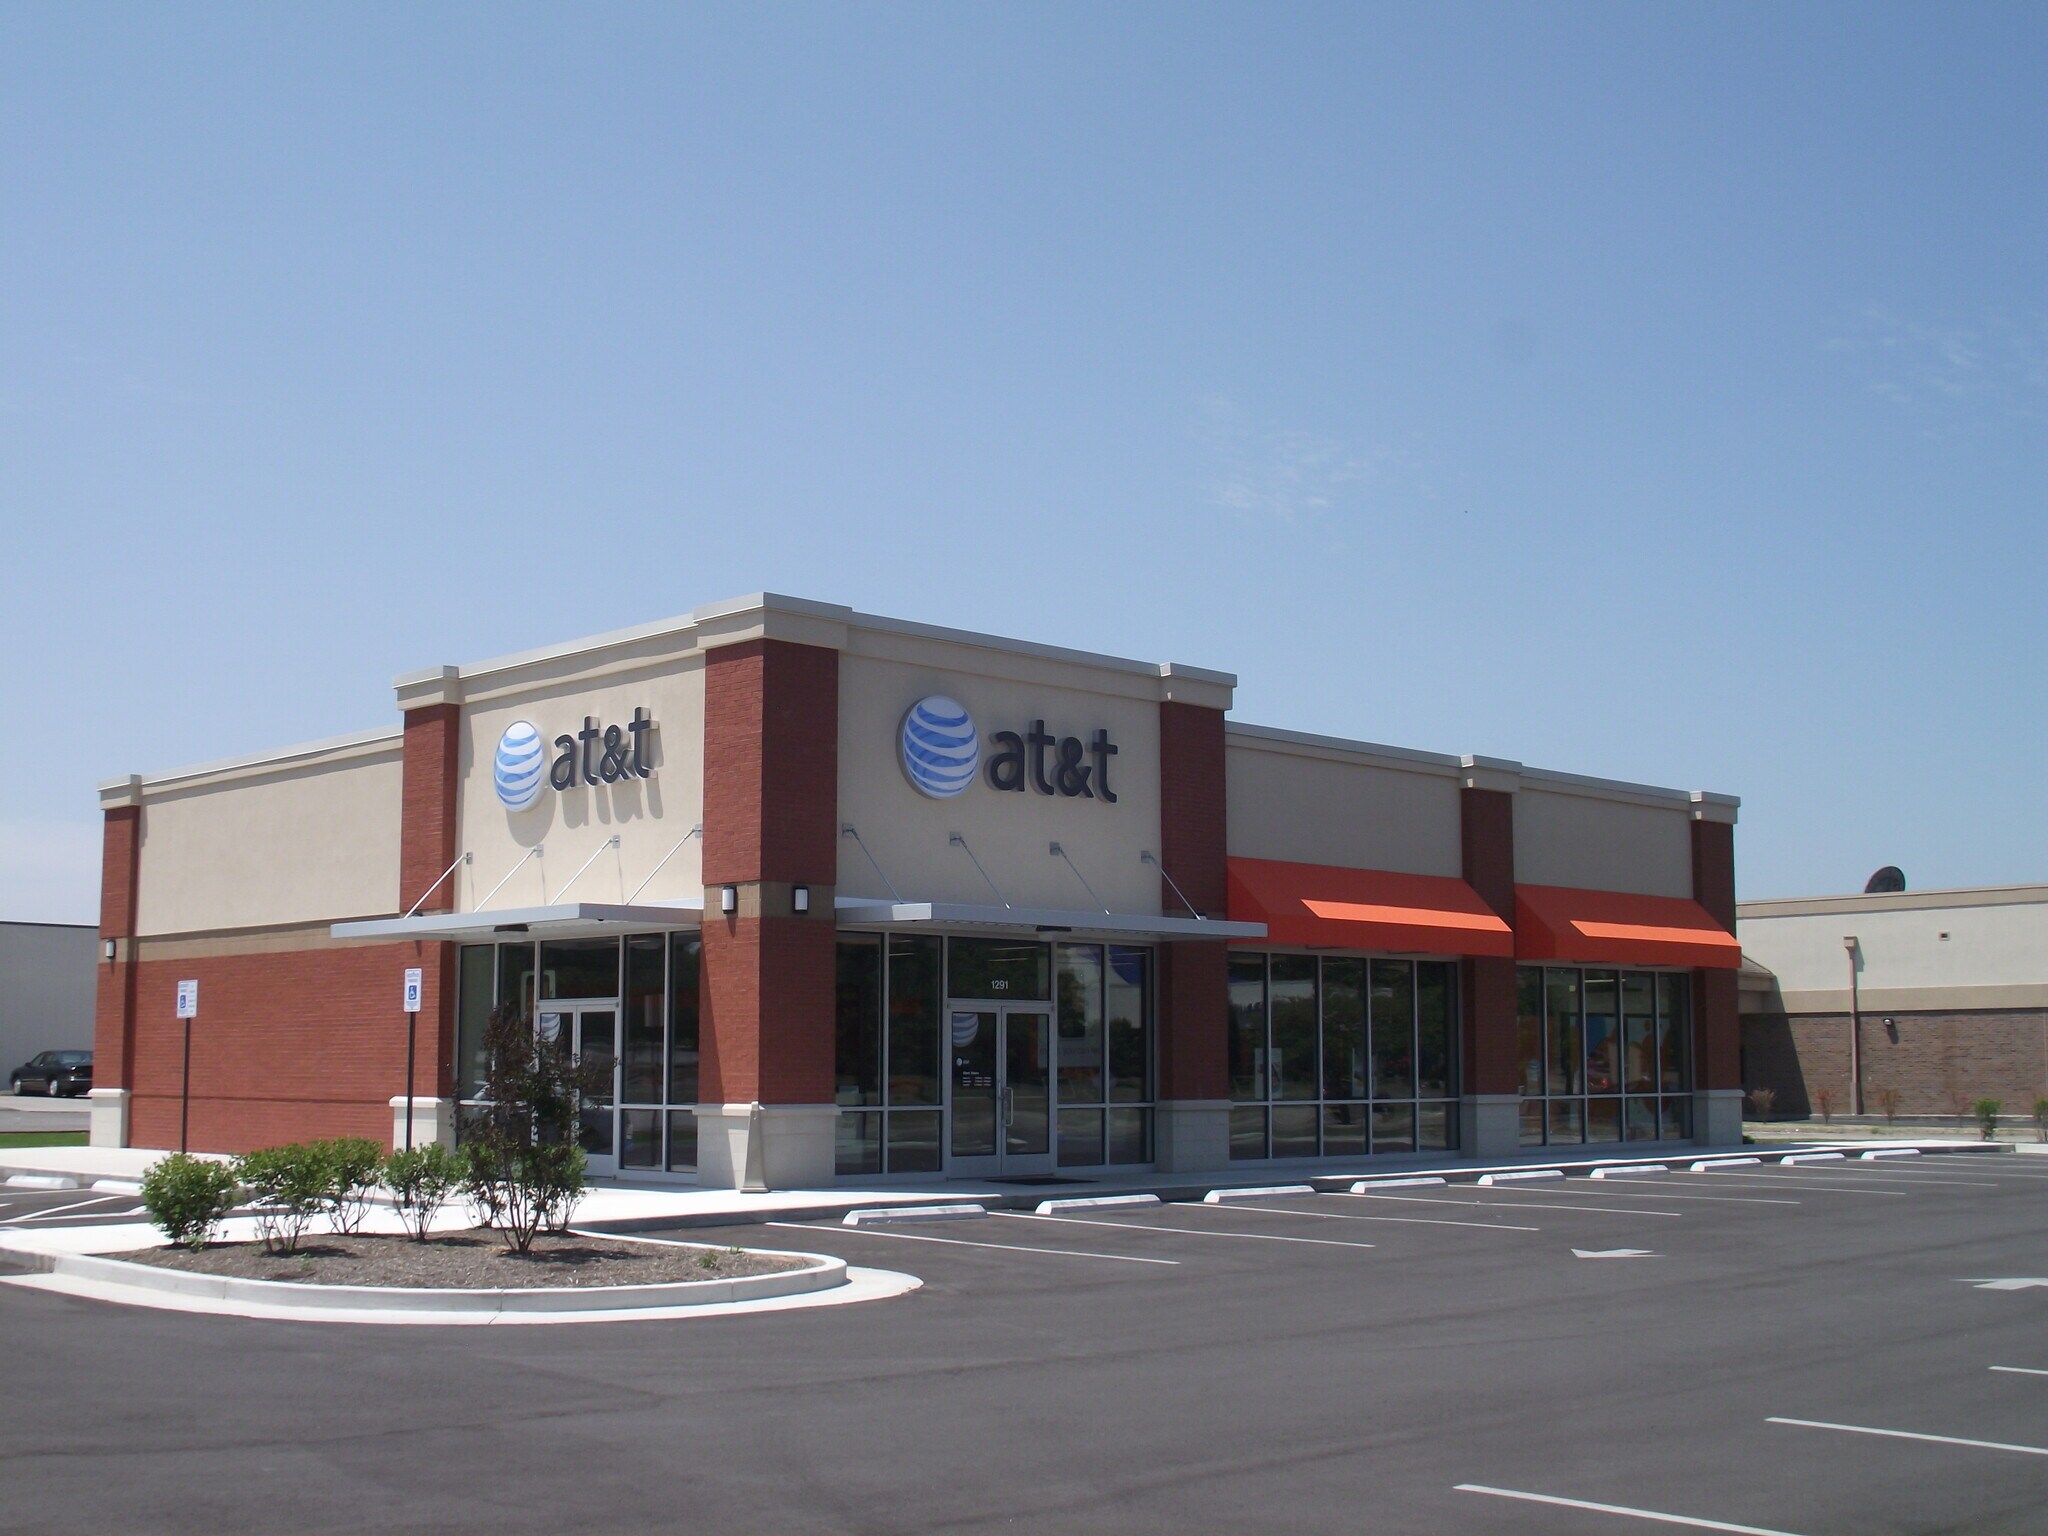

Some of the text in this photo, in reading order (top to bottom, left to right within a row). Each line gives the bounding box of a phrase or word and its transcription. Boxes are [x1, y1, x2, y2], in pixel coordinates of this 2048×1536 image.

[550, 706, 651, 791] at&t
[988, 719, 1118, 803] at&t
[991, 979, 1009, 990] 1291
